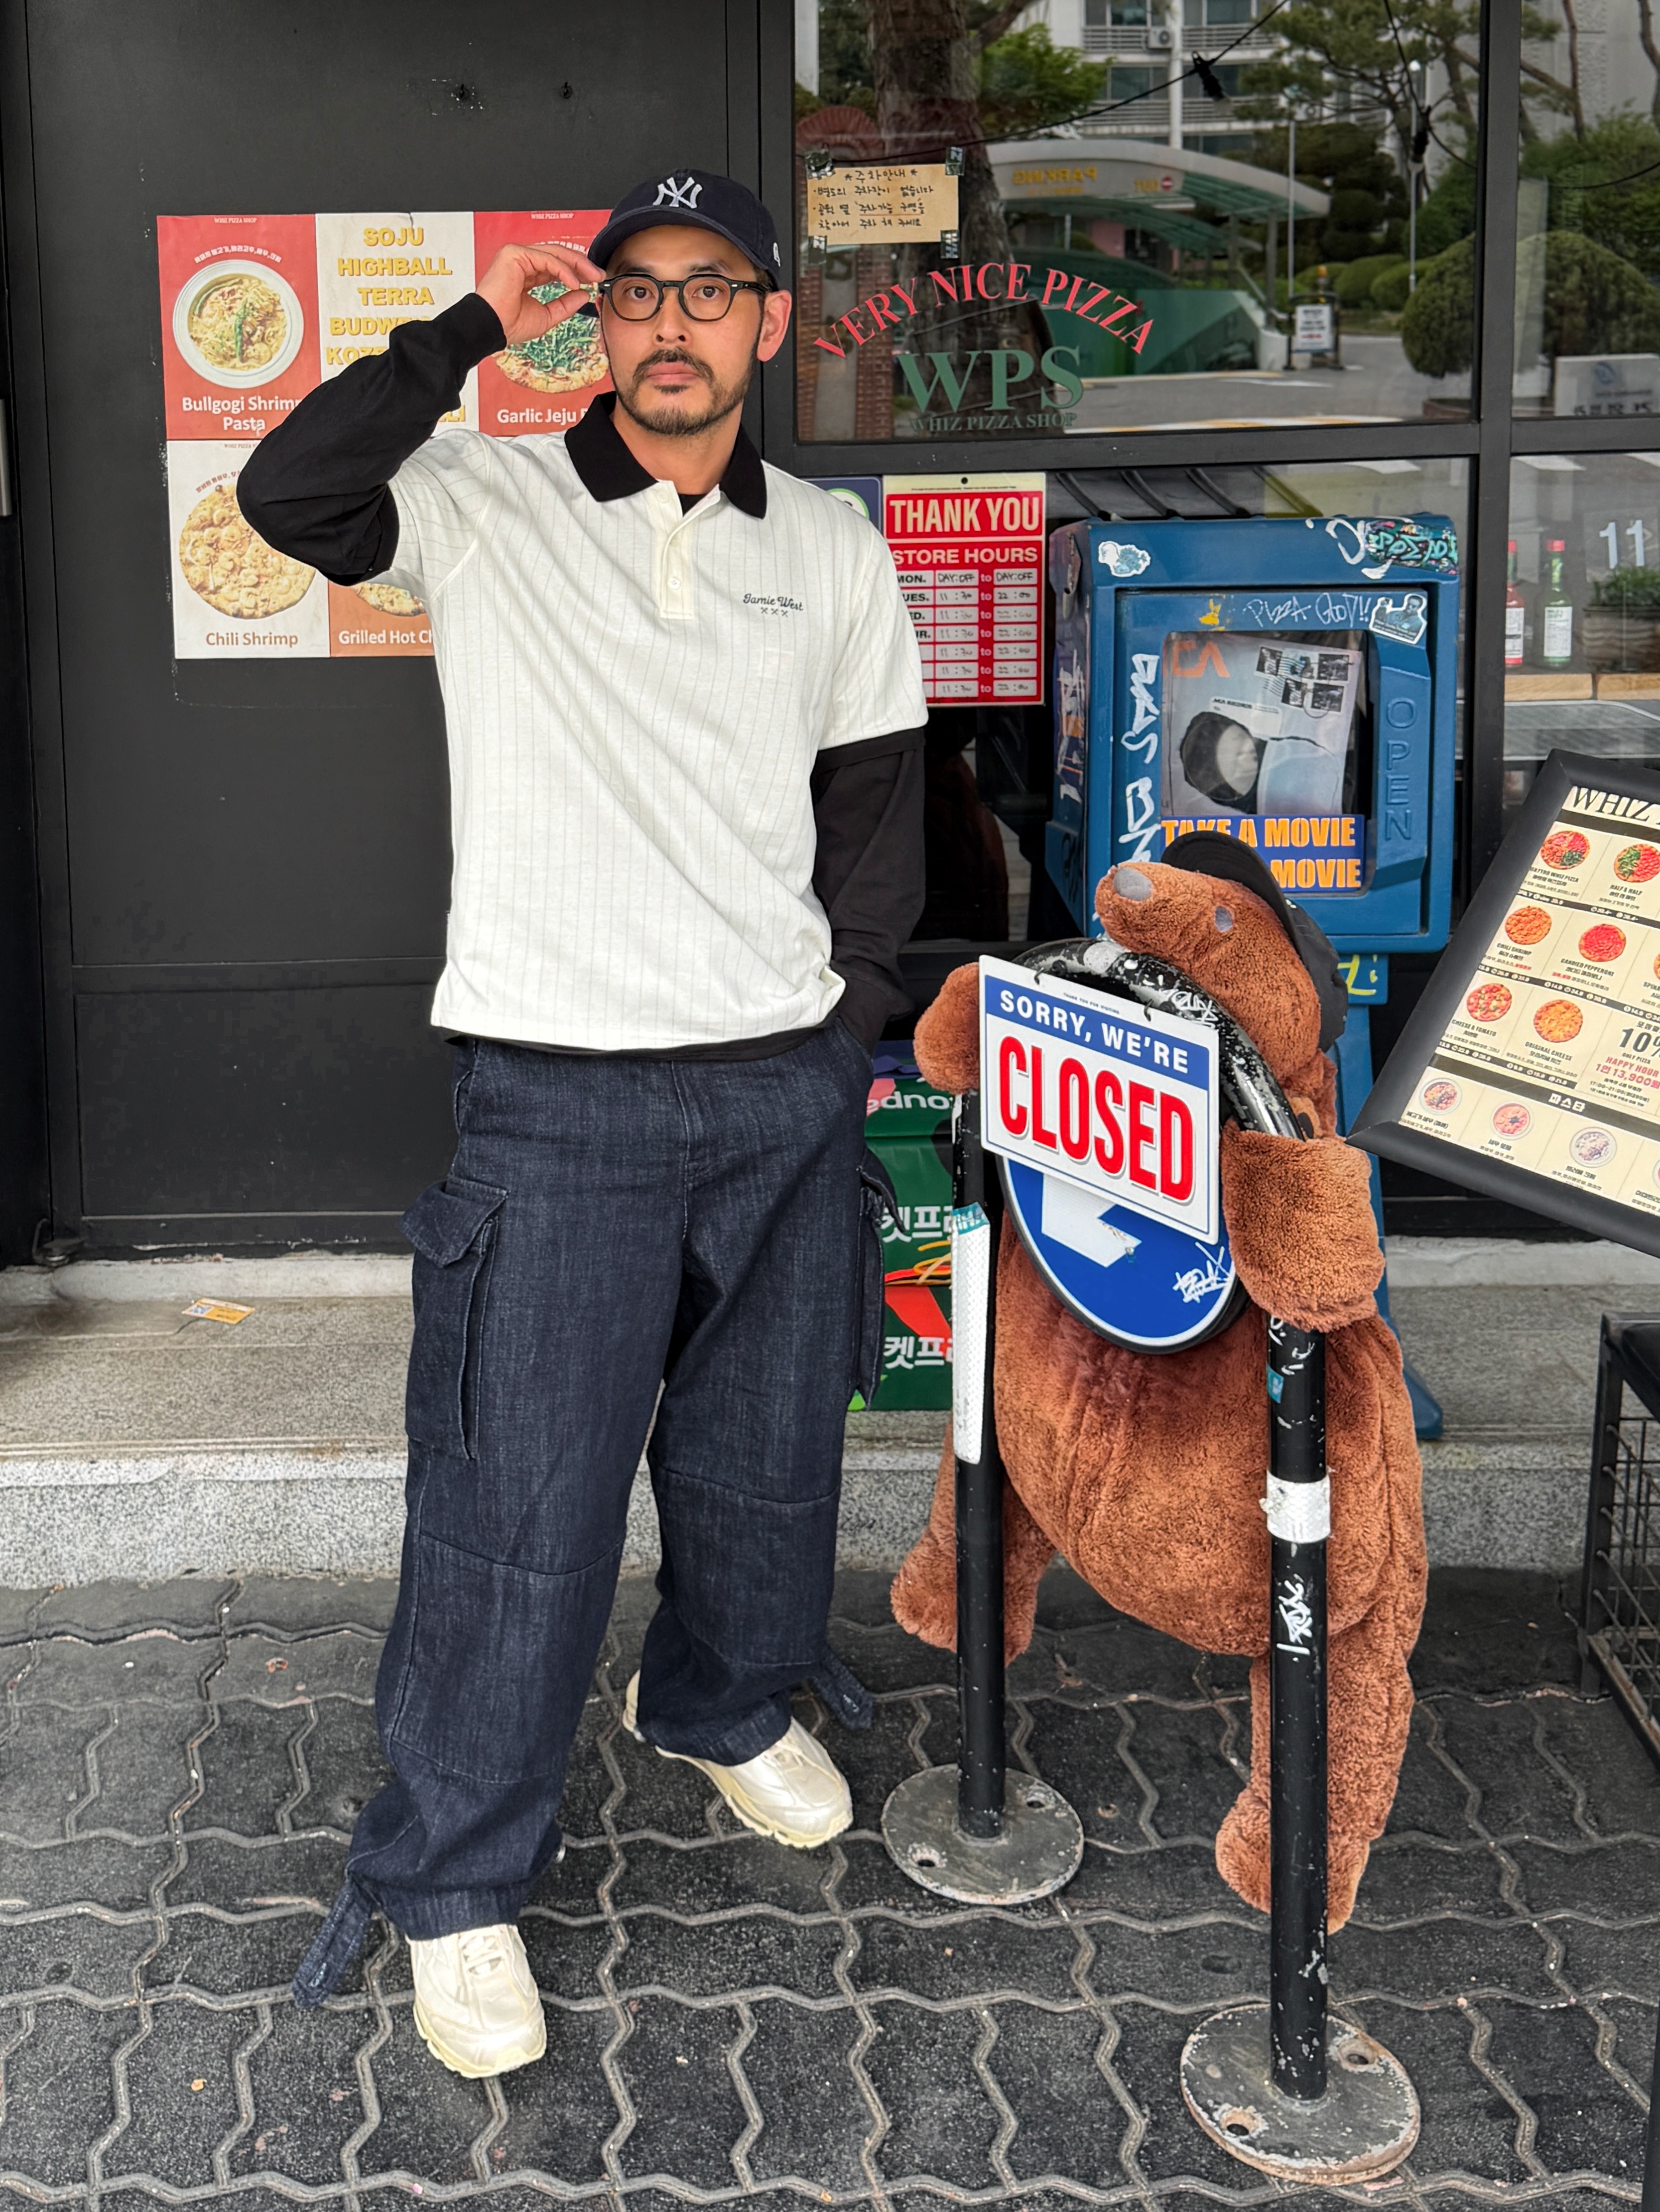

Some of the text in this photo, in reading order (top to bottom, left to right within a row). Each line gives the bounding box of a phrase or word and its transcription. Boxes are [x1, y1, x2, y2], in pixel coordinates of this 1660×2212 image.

[363, 227, 424, 246] SOJU
[338, 257, 452, 276] HIGHBALL
[357, 286, 434, 305] TERRA
[813, 262, 1154, 359] VERY NICE PIZZA
[896, 346, 1084, 413] WPS
[182, 396, 245, 414] Bullgogi
[223, 416, 265, 432] Pasta
[497, 409, 542, 423] Garlic
[545, 408, 577, 425] Jeju
[911, 413, 1077, 432] WHIZ PIZZA SHOP
[890, 496, 1039, 533] THANK YOU
[1599, 519, 1645, 569] 11
[893, 547, 1038, 565] STORE HOURS
[980, 573, 992, 582] to
[743, 593, 803, 611] Jamie West
[902, 593, 930, 602] UES.
[980, 592, 992, 601] to
[980, 611, 992, 619] to
[206, 631, 298, 648] Chili Shrimp
[339, 629, 386, 644] Grilled
[390, 629, 416, 644] Hot
[980, 629, 992, 638] to
[980, 648, 992, 656] to
[980, 666, 992, 675] to
[980, 684, 992, 693] to
[1572, 785, 1650, 822] WHIZ
[1264, 817, 1356, 848] MOVIE
[1270, 859, 1361, 888] MOVIE
[1000, 989, 1188, 1075] SORRY, WE'RE
[1605, 1056, 1660, 1078] HAPPY HOUR
[1548, 1093, 1586, 1112] 파스타
[1000, 1035, 1195, 1204] CLOSED
